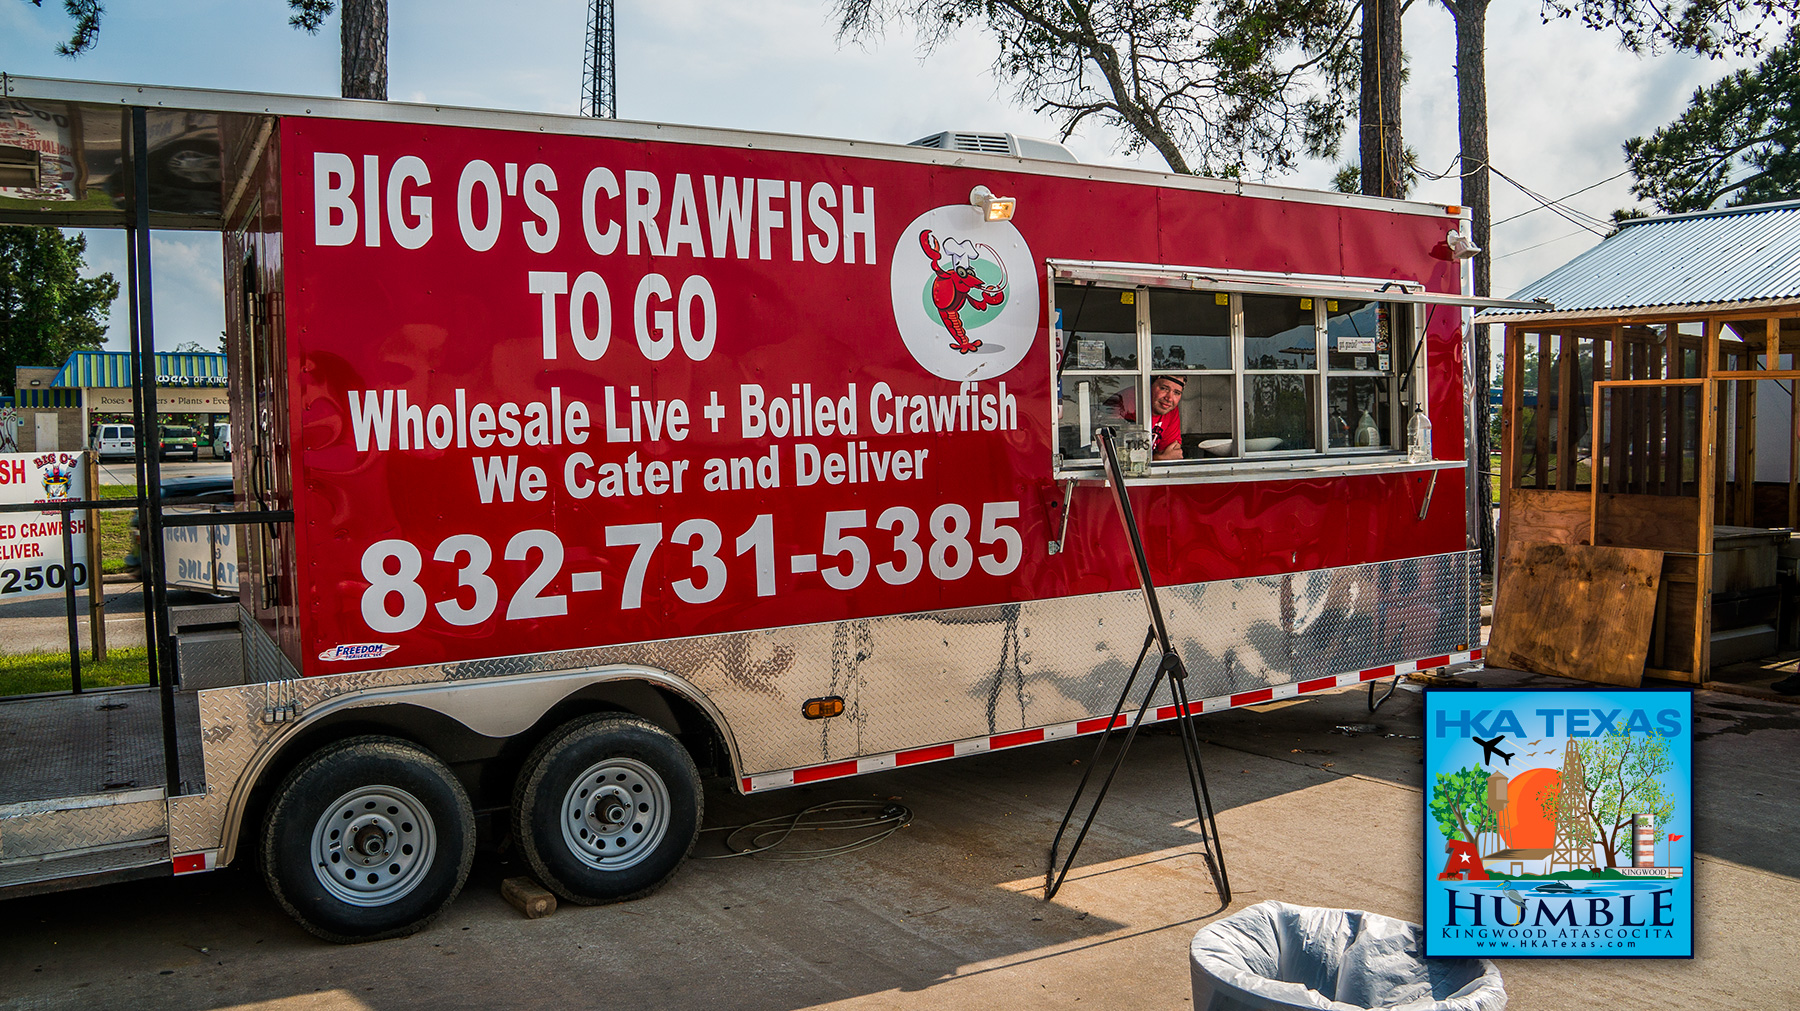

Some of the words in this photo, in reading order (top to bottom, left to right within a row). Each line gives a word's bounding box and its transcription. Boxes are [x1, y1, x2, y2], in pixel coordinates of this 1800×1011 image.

[313, 151, 433, 250] BIG
[457, 159, 560, 254] O'S
[581, 166, 877, 265] CRAWFISH
[528, 270, 612, 361] TO
[633, 273, 717, 361] GO
[194, 376, 205, 384] OF
[101, 396, 125, 405] Roses
[178, 396, 203, 405] Plants
[347, 388, 590, 452] Wholesale
[604, 385, 690, 443] Live
[703, 391, 726, 433] +
[740, 383, 858, 439] Boiled
[869, 381, 1018, 435] Crawfish
[1125, 439, 1150, 450] TIPS
[33, 453, 57, 470] BIG
[472, 454, 548, 504] We
[564, 451, 690, 499] Cater
[703, 444, 780, 492] and
[794, 440, 929, 487] Deliver
[20, 519, 87, 538] CRAWFSH
[0, 562, 87, 595] 2500
[360, 500, 1023, 634] 832-731-5385
[336, 644, 383, 656] FREEDOM
